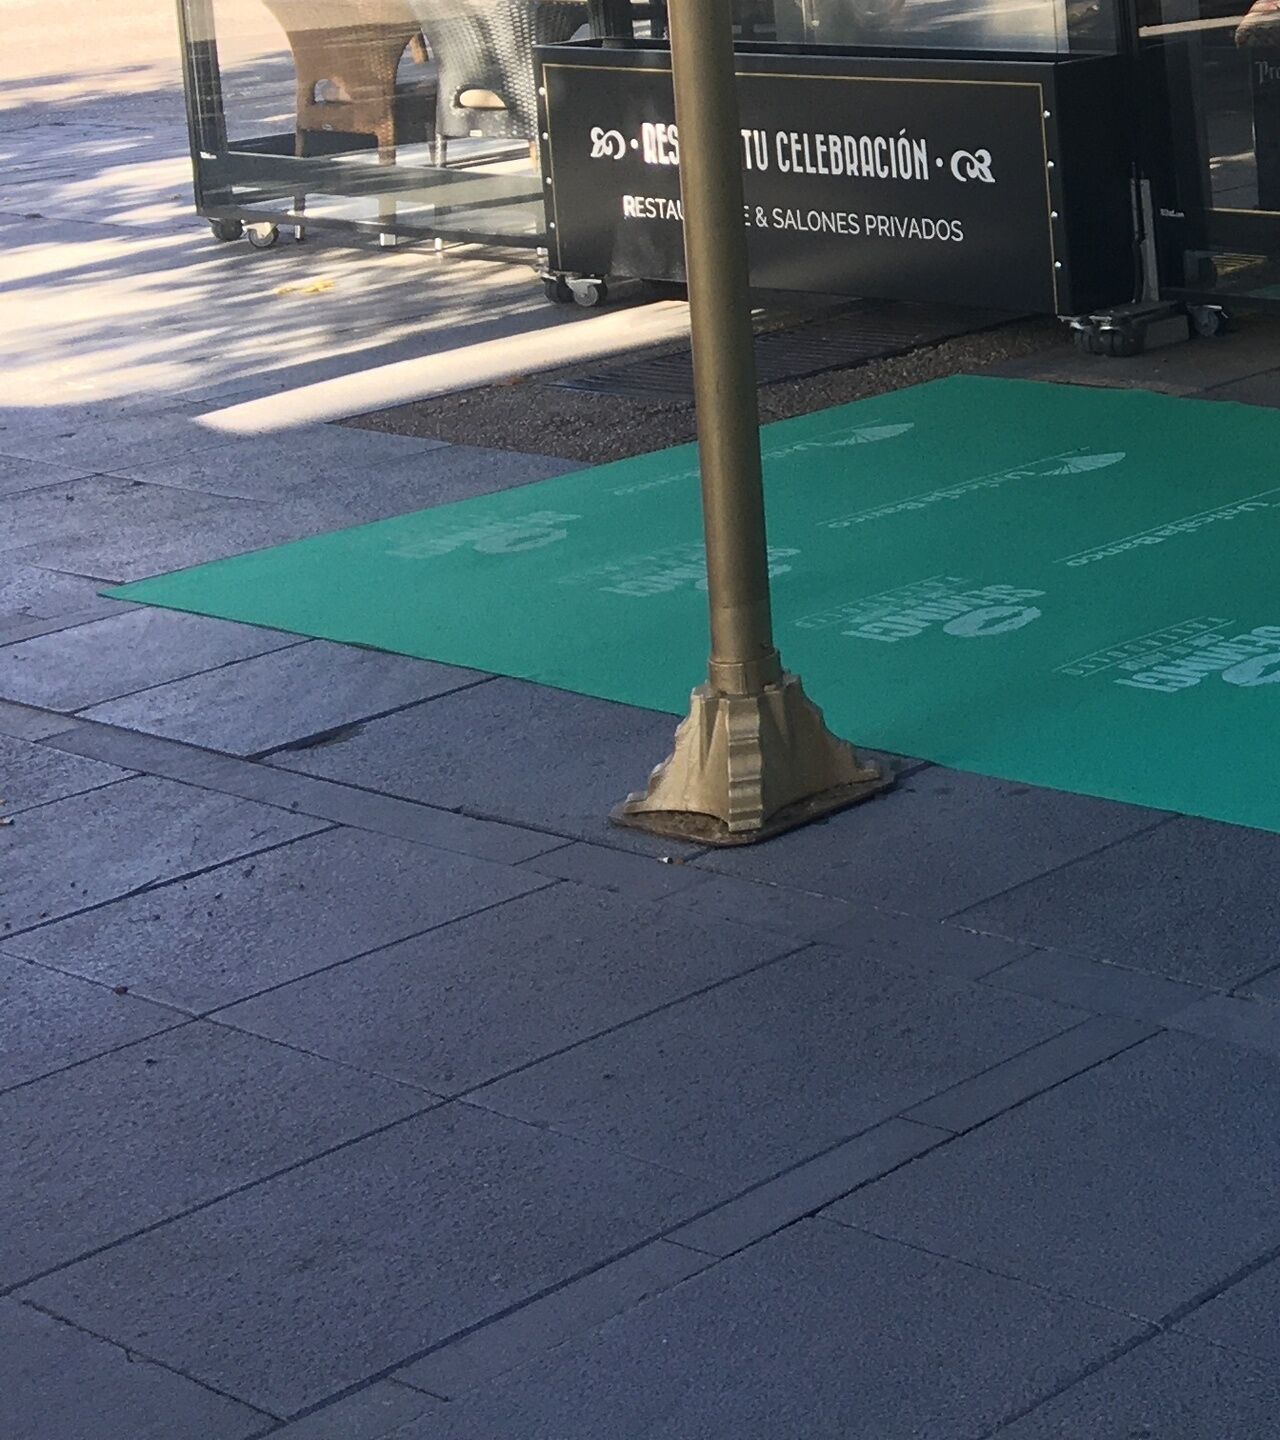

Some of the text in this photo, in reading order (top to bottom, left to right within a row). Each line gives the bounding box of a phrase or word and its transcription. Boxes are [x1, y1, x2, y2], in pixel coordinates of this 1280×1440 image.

[741, 129, 768, 171] TU
[775, 128, 929, 181] CELEBRACIÓN
[755, 206, 769, 228] &
[772, 208, 861, 235] SALONES
[864, 215, 964, 242] PRIVADOS
